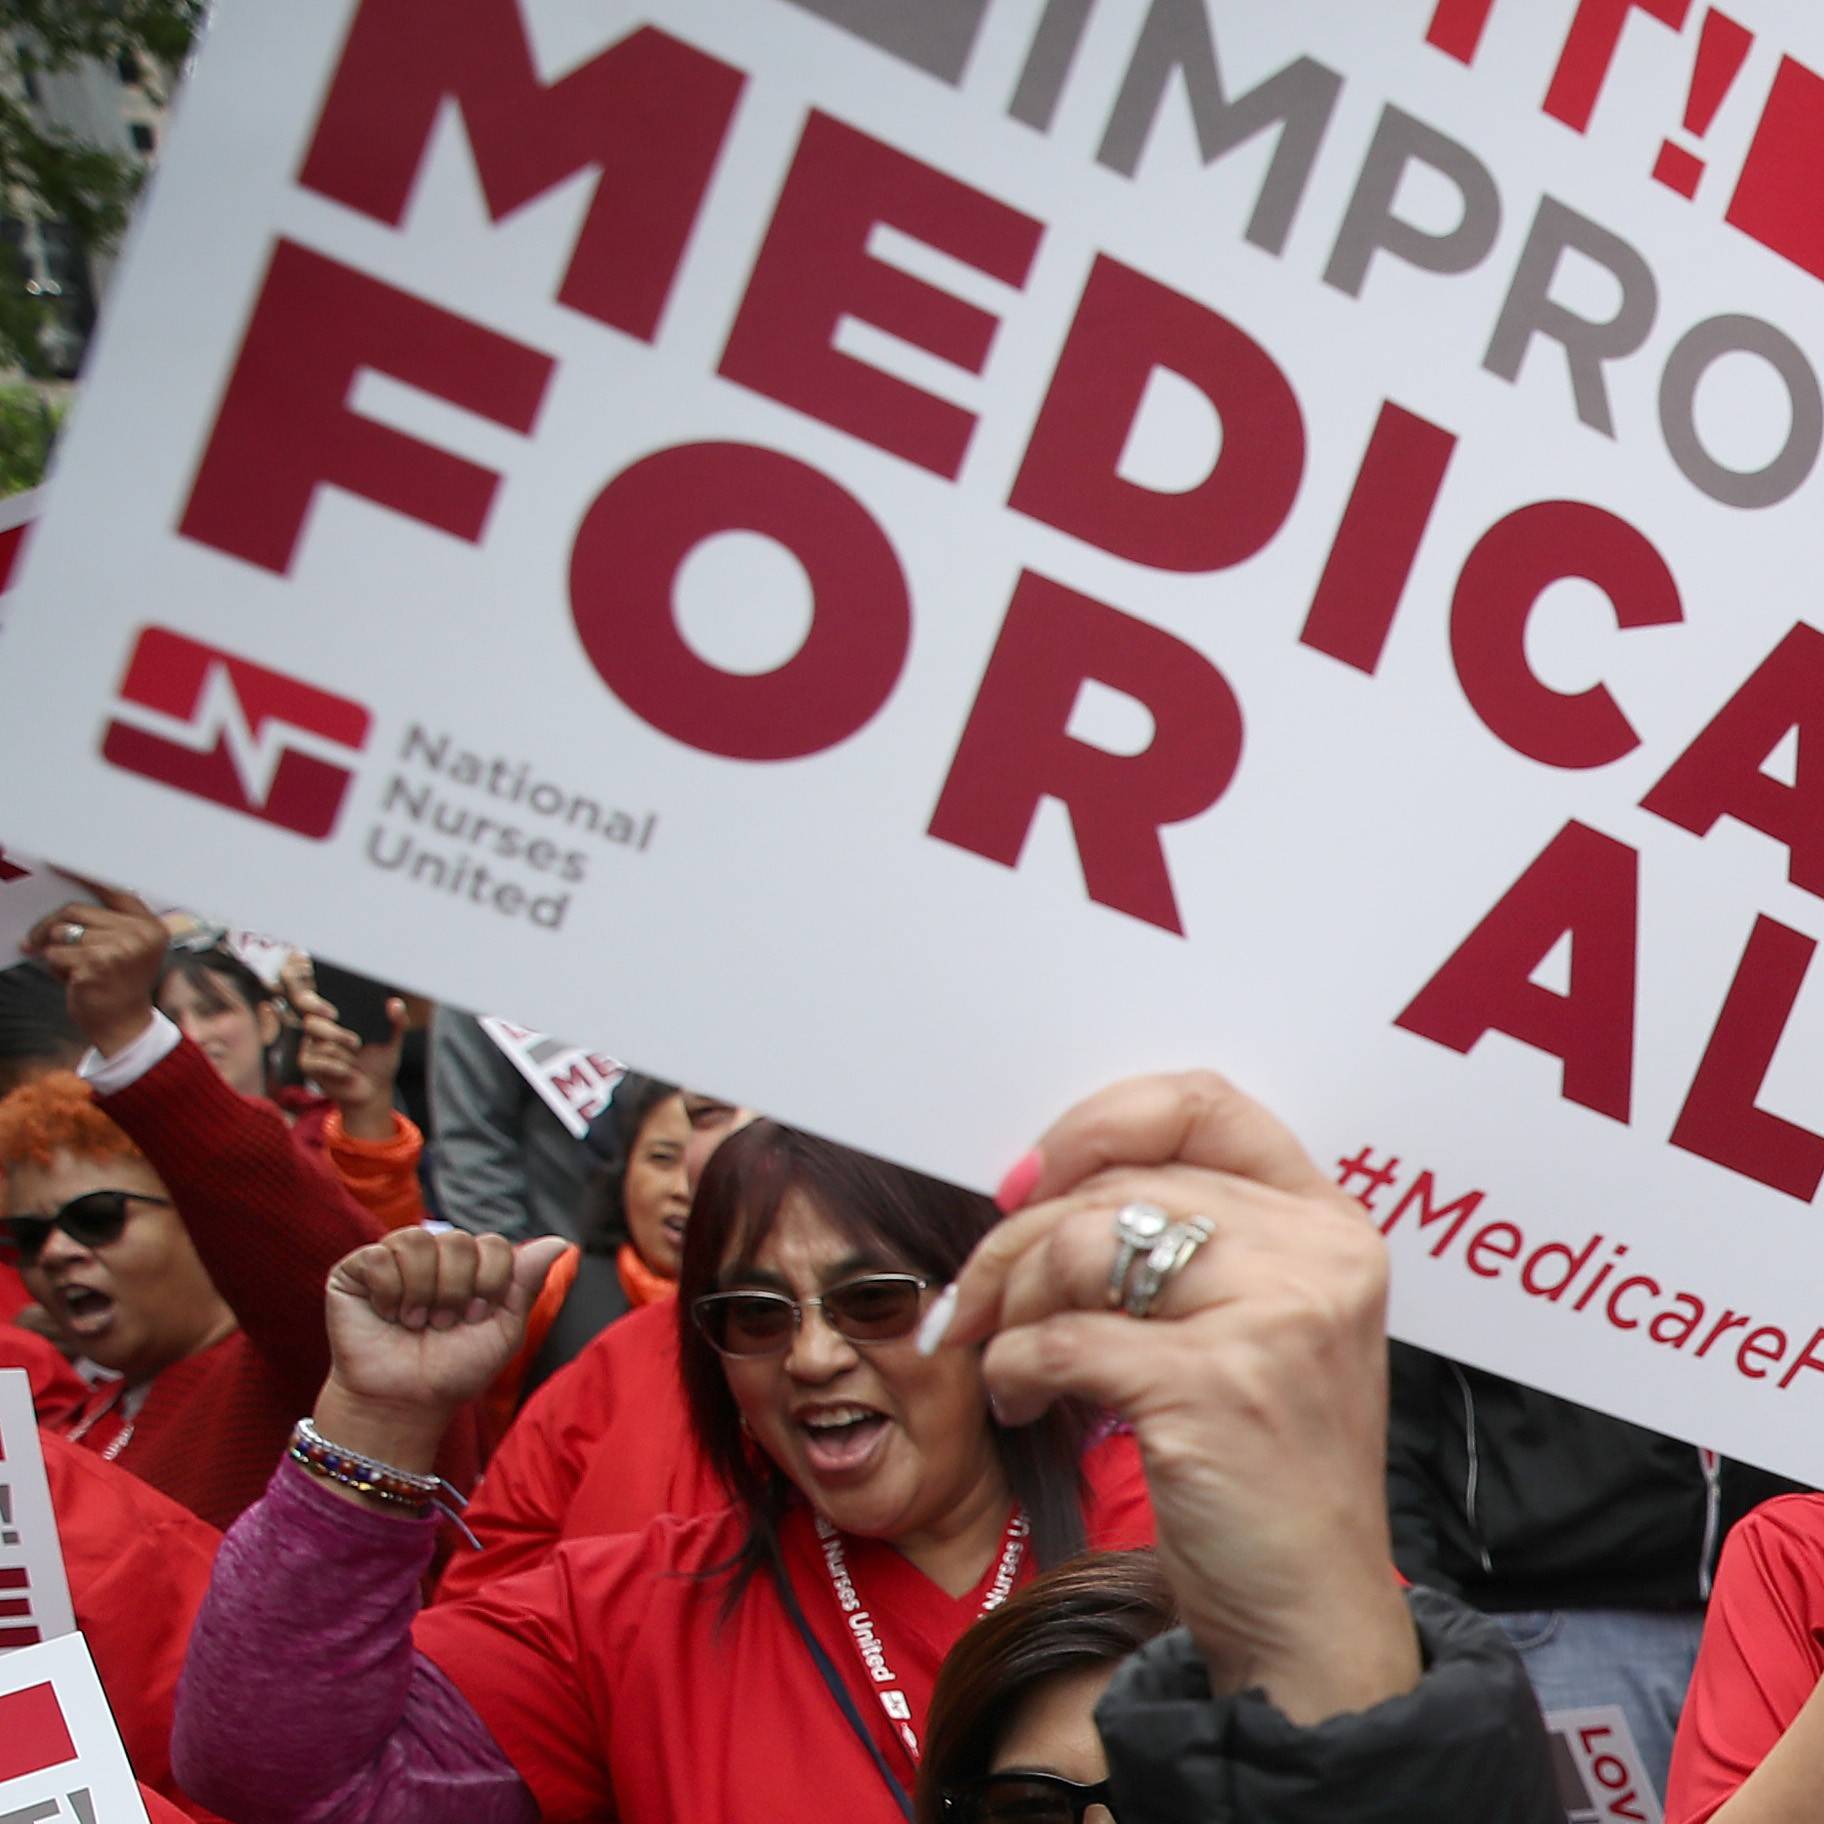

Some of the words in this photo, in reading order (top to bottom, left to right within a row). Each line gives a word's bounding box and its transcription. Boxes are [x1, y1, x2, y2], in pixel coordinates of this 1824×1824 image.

[177, 233, 1245, 940] FOR
[379, 776, 591, 885] Nurses
[397, 722, 659, 855] National
[363, 830, 573, 934] United
[821, 1539, 861, 1612] Nurses
[847, 1599, 896, 1684] United
